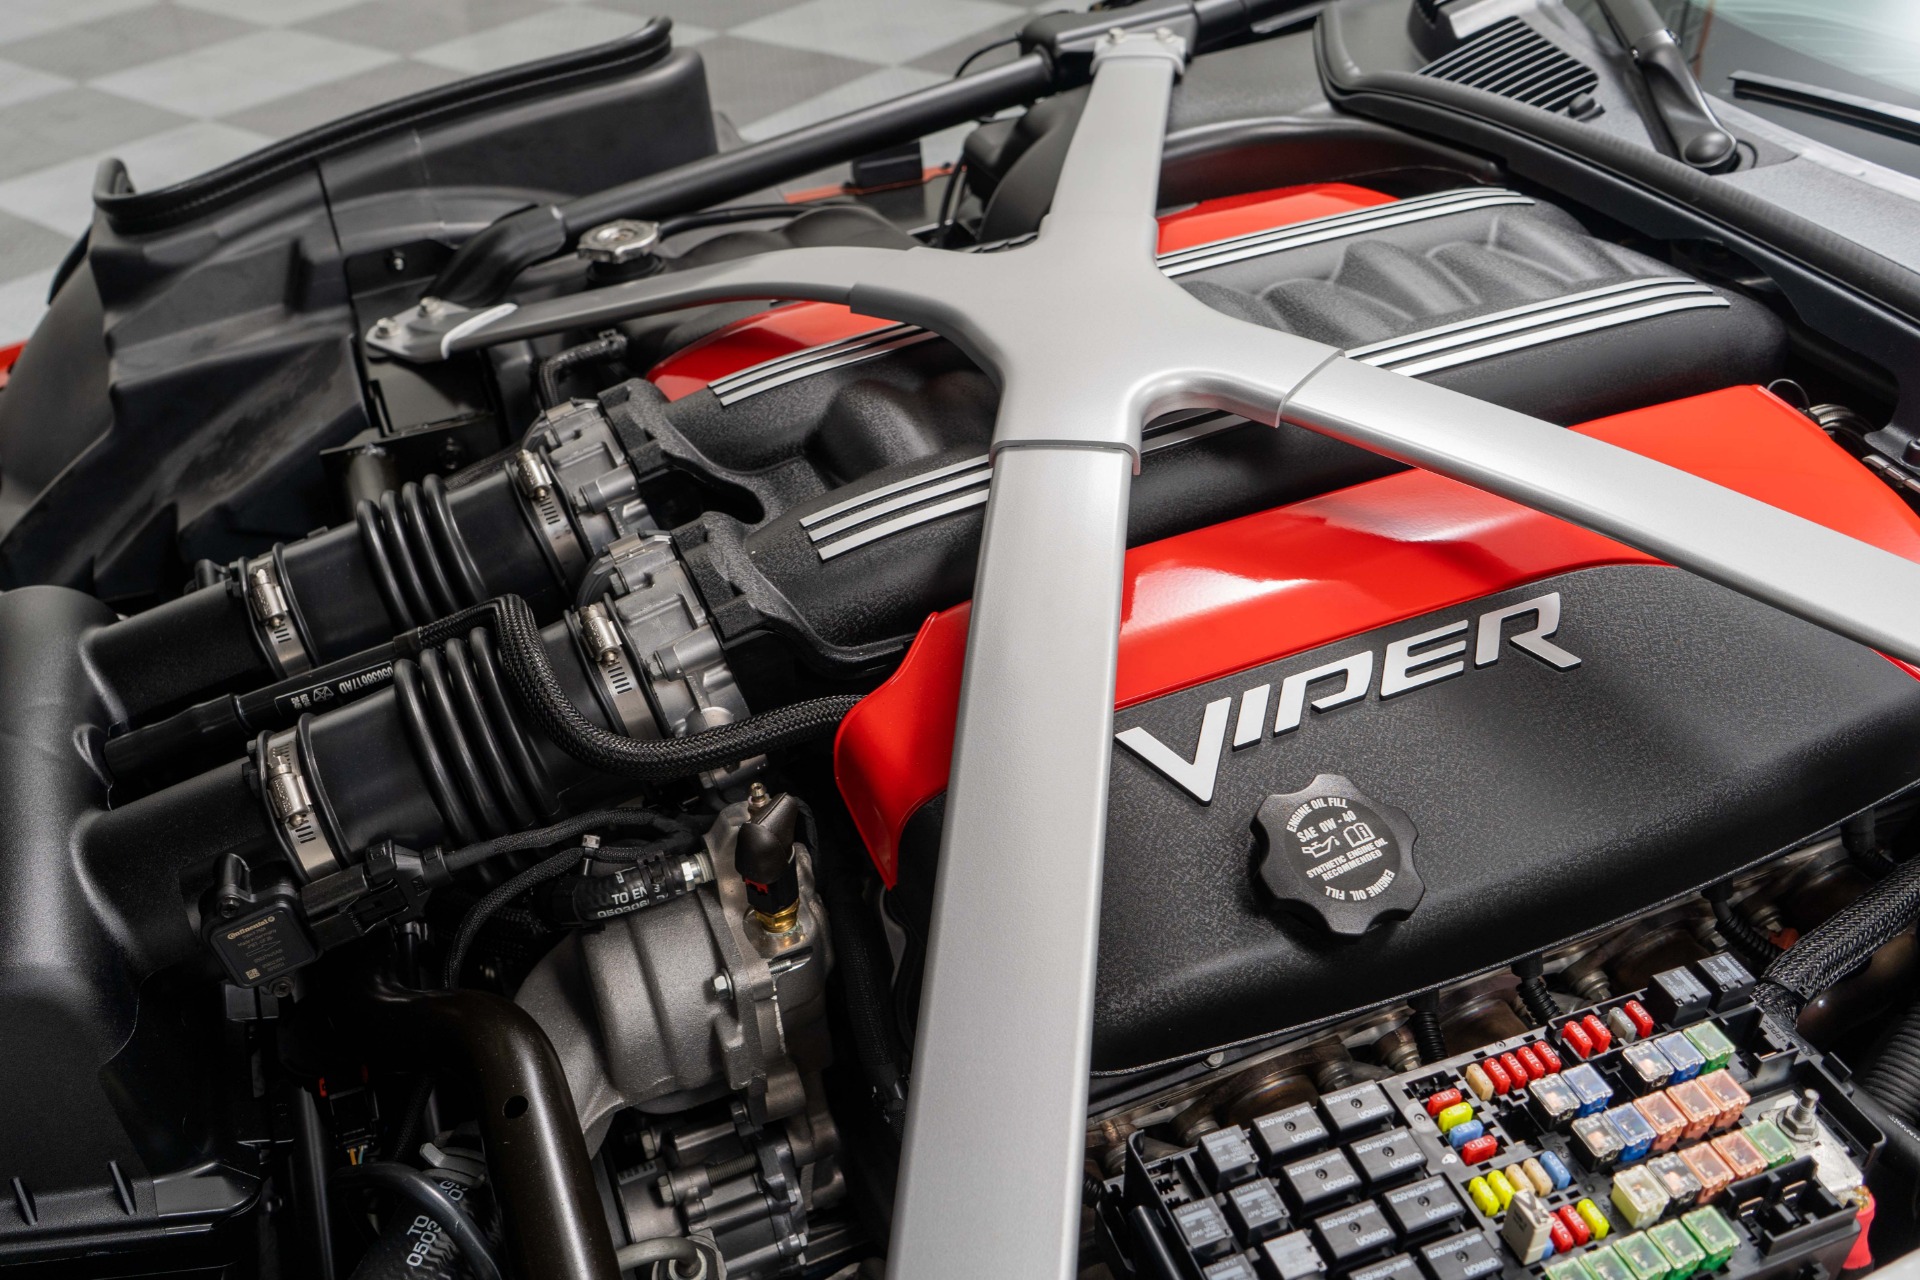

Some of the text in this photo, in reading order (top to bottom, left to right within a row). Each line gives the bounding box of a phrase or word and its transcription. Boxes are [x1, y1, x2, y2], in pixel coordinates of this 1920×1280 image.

[1114, 591, 1581, 806] VIPER
[1287, 797, 1348, 833] ENGINE OIL FILL
[1296, 826, 1319, 843] SAE
[1342, 810, 1357, 823] 40
[1306, 837, 1388, 878] SYNTHETIC ENGINE OIL
[1321, 849, 1383, 881] RECOMMENDED
[1325, 869, 1395, 901] ENGINE OIL FILL
[612, 893, 629, 905] TO
[227, 918, 269, 940] Continental
[1633, 1005, 1648, 1016] 10
[1591, 1019, 1604, 1030] 10
[1572, 1027, 1584, 1039] 10
[1525, 1051, 1539, 1064] 10
[1542, 1046, 1555, 1057] 10
[1490, 1062, 1504, 1074] 10
[1508, 1057, 1521, 1070] 10
[1439, 1090, 1454, 1101] 10
[1473, 1137, 1488, 1148] 10
[406, 1215, 429, 1235] TO
